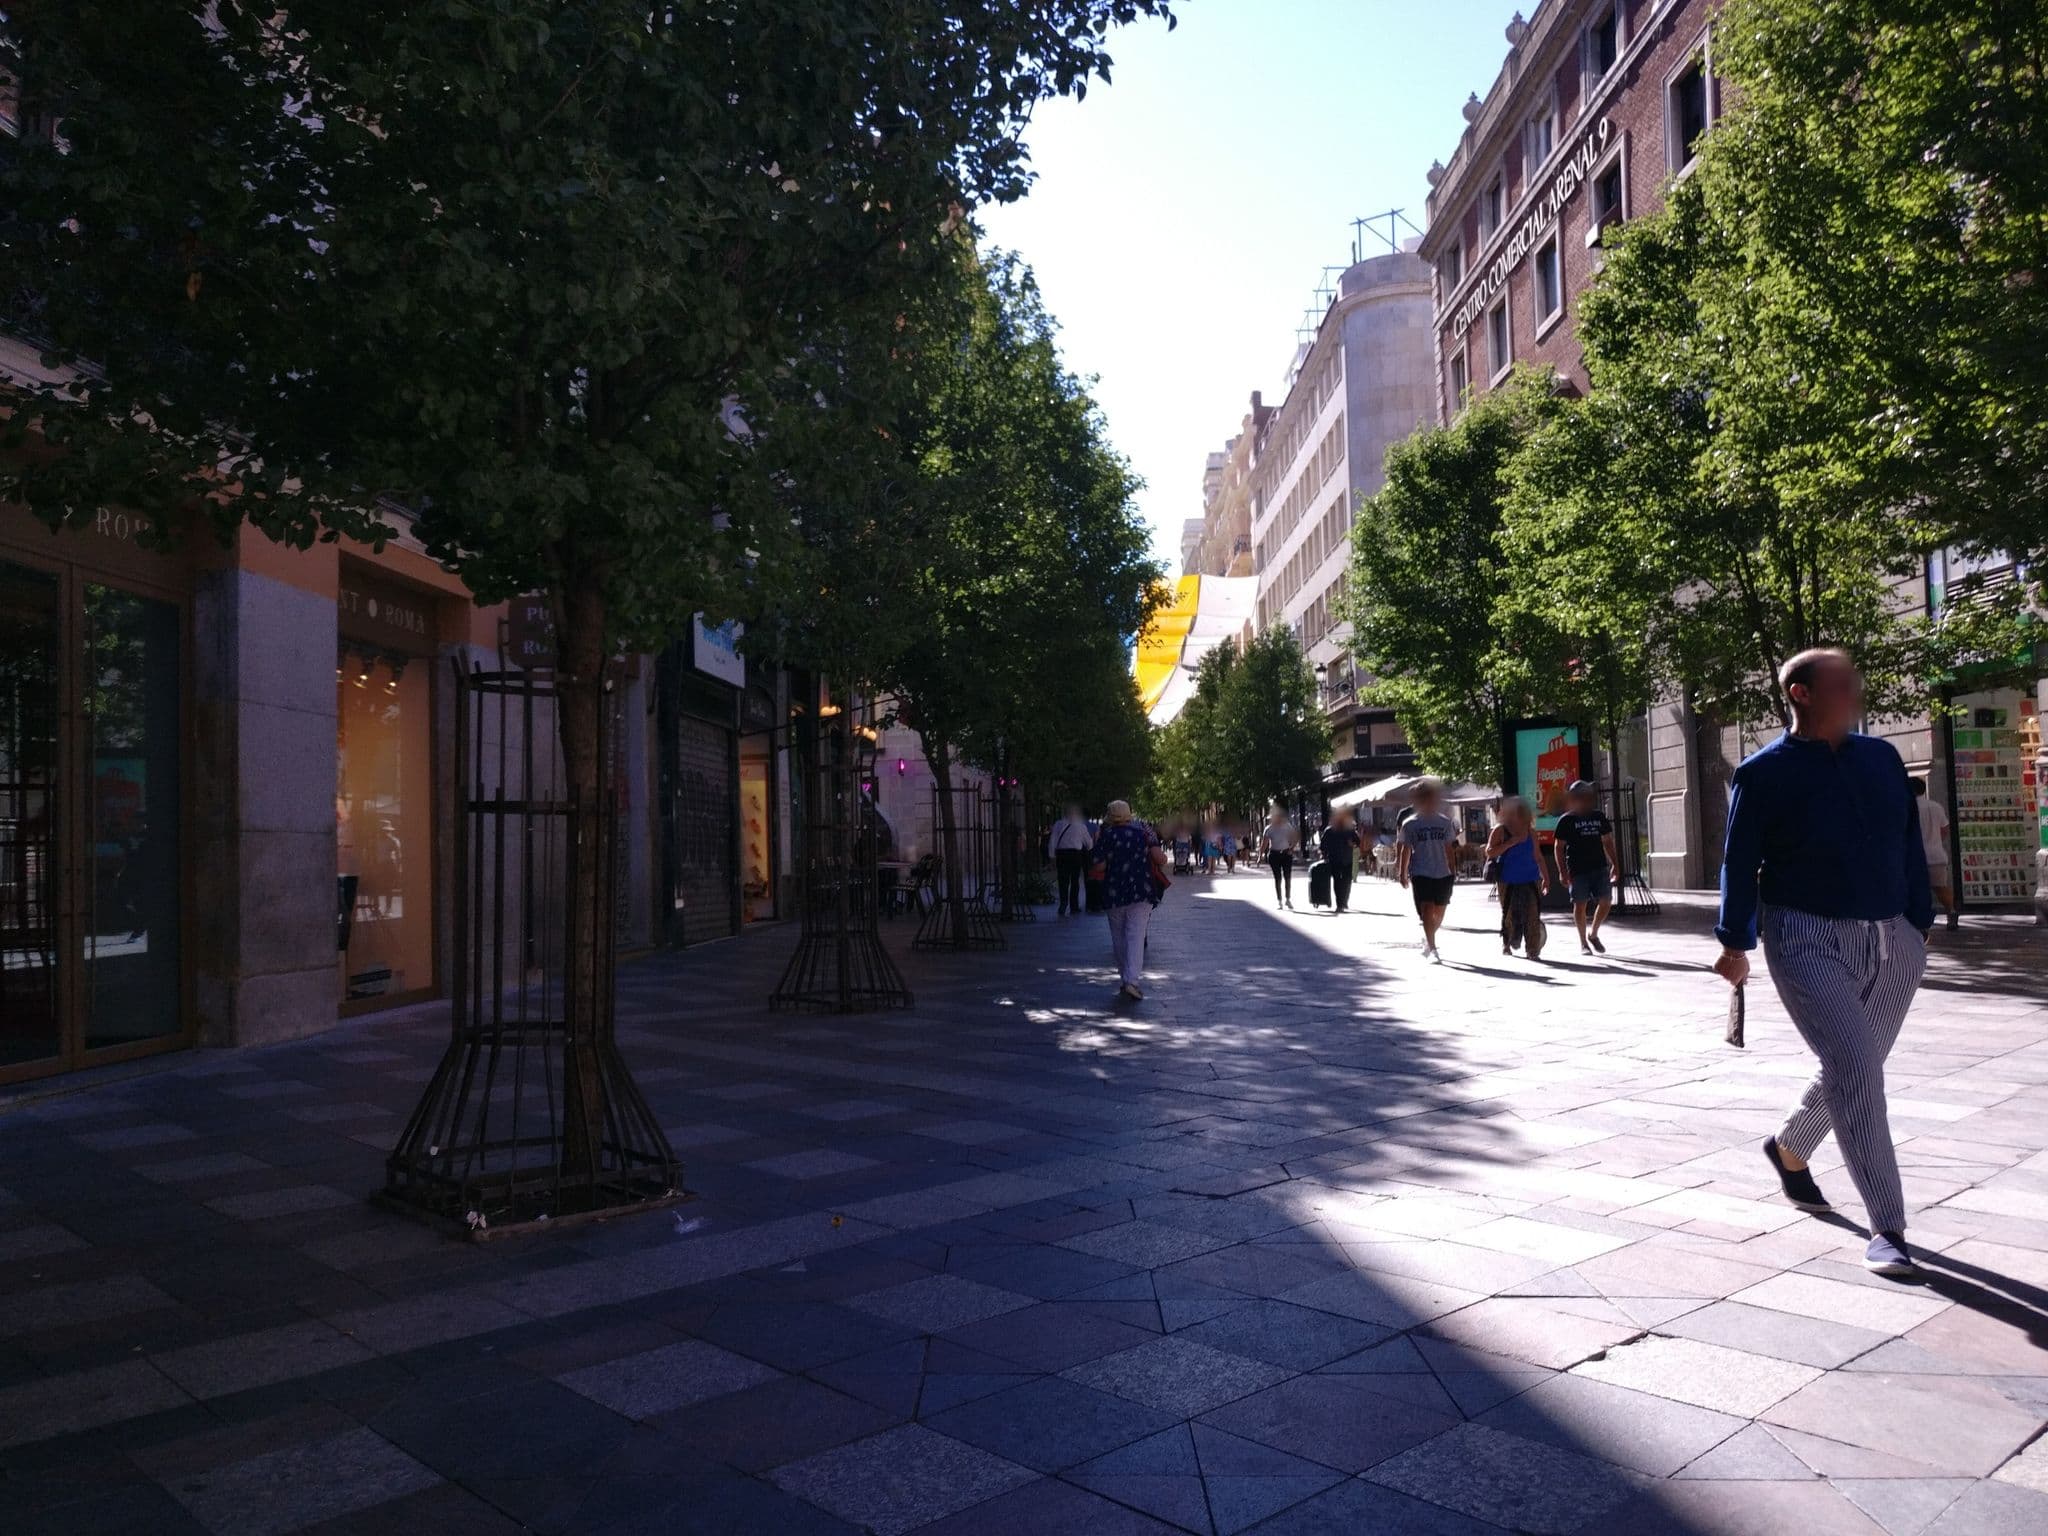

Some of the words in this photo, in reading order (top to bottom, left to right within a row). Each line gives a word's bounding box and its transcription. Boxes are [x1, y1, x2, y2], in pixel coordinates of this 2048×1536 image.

[1453, 278, 1487, 340] CENTRO
[1488, 202, 1547, 294] COMERCIAL
[1548, 133, 1598, 220] ARENAL
[1599, 117, 1608, 153] 9
[385, 603, 425, 635] ROMA
